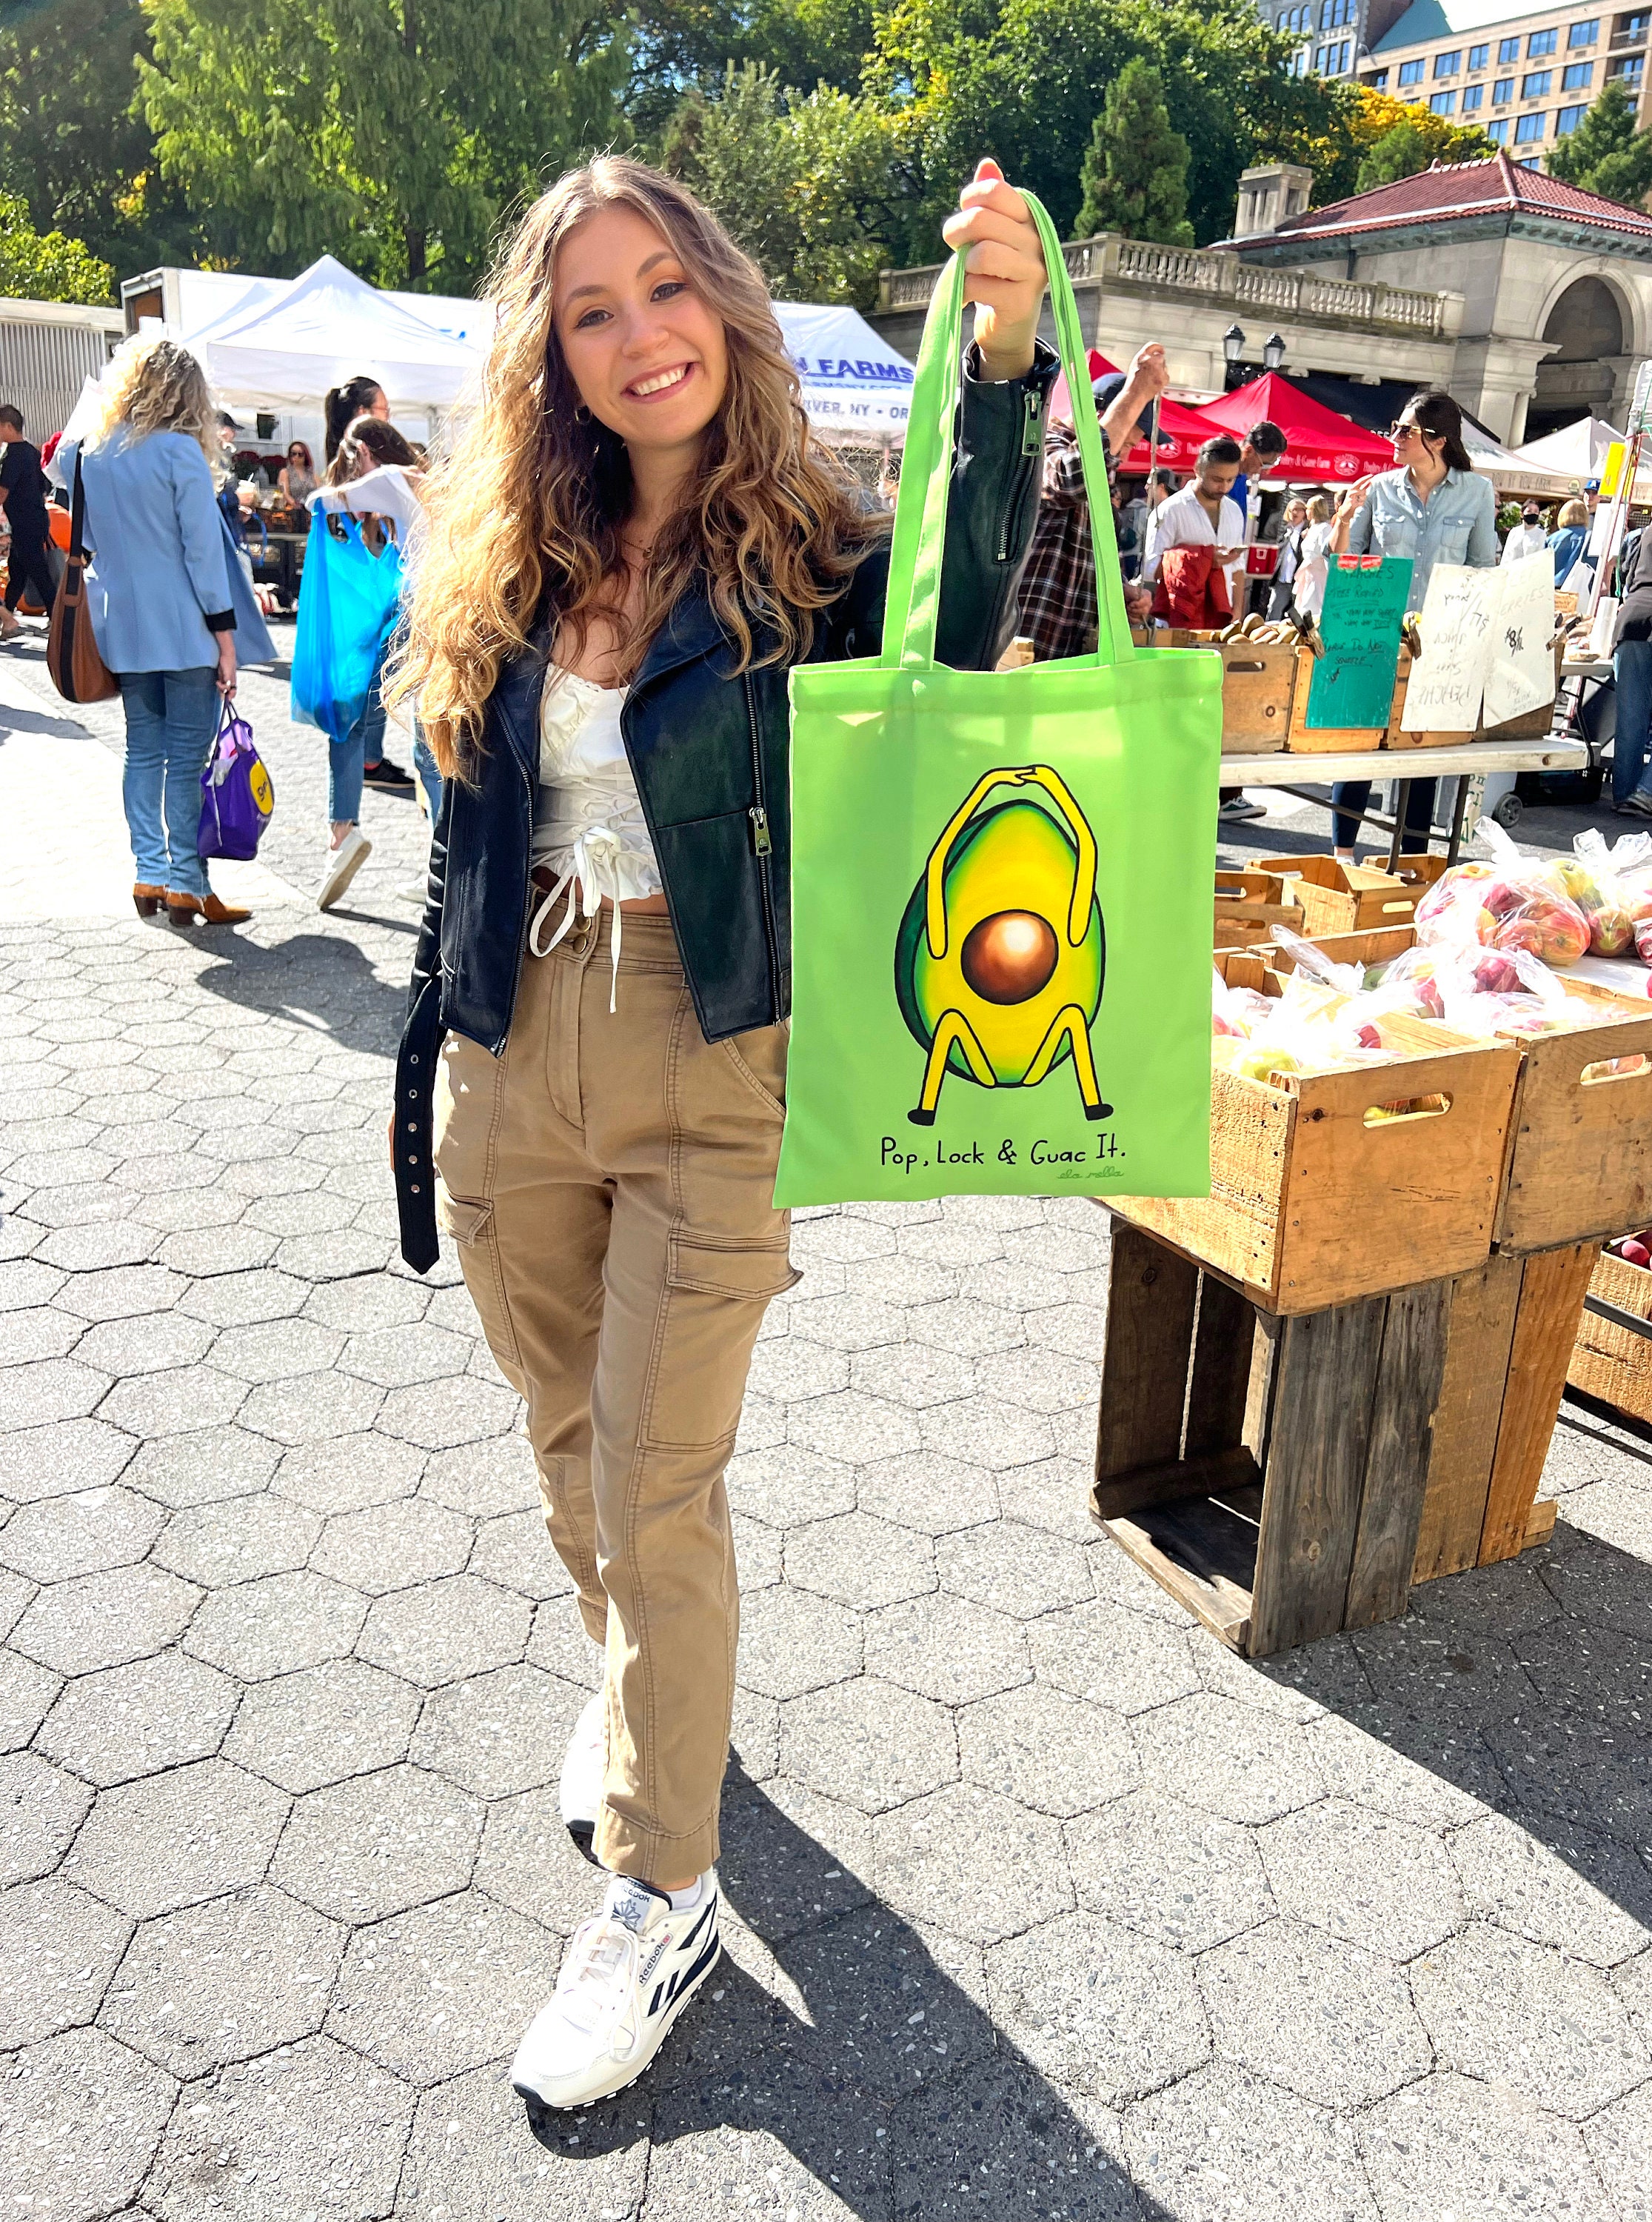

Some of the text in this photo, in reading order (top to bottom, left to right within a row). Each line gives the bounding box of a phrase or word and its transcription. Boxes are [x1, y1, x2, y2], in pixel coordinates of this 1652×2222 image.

[818, 359, 914, 381] FARMS
[881, 1132, 1126, 1174] Pop, Lock & Guac It.
[639, 1941, 666, 1984] Reebok
